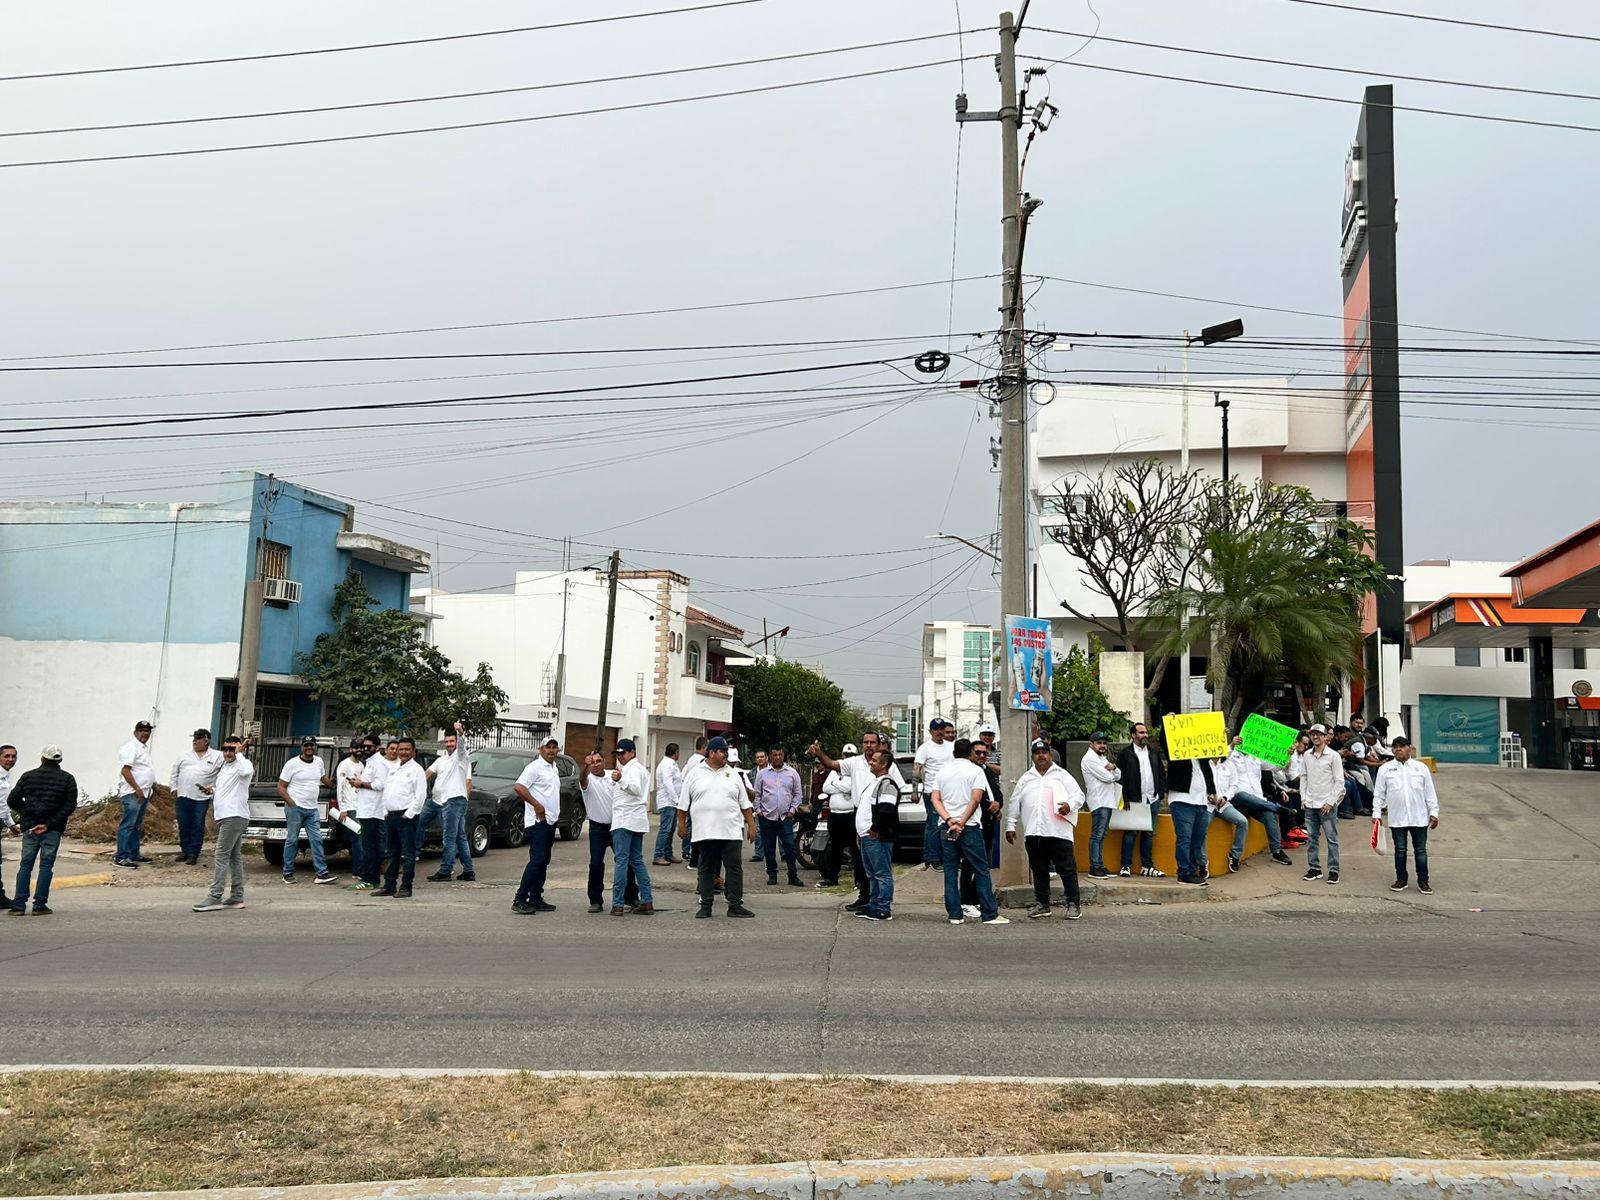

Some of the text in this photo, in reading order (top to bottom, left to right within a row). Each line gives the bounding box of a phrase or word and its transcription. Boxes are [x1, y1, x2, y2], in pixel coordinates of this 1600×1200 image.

[1028, 630, 1046, 640] TODOS
[1248, 714, 1283, 735] GRACIAS
[1174, 746, 1224, 759] GRACIAS
